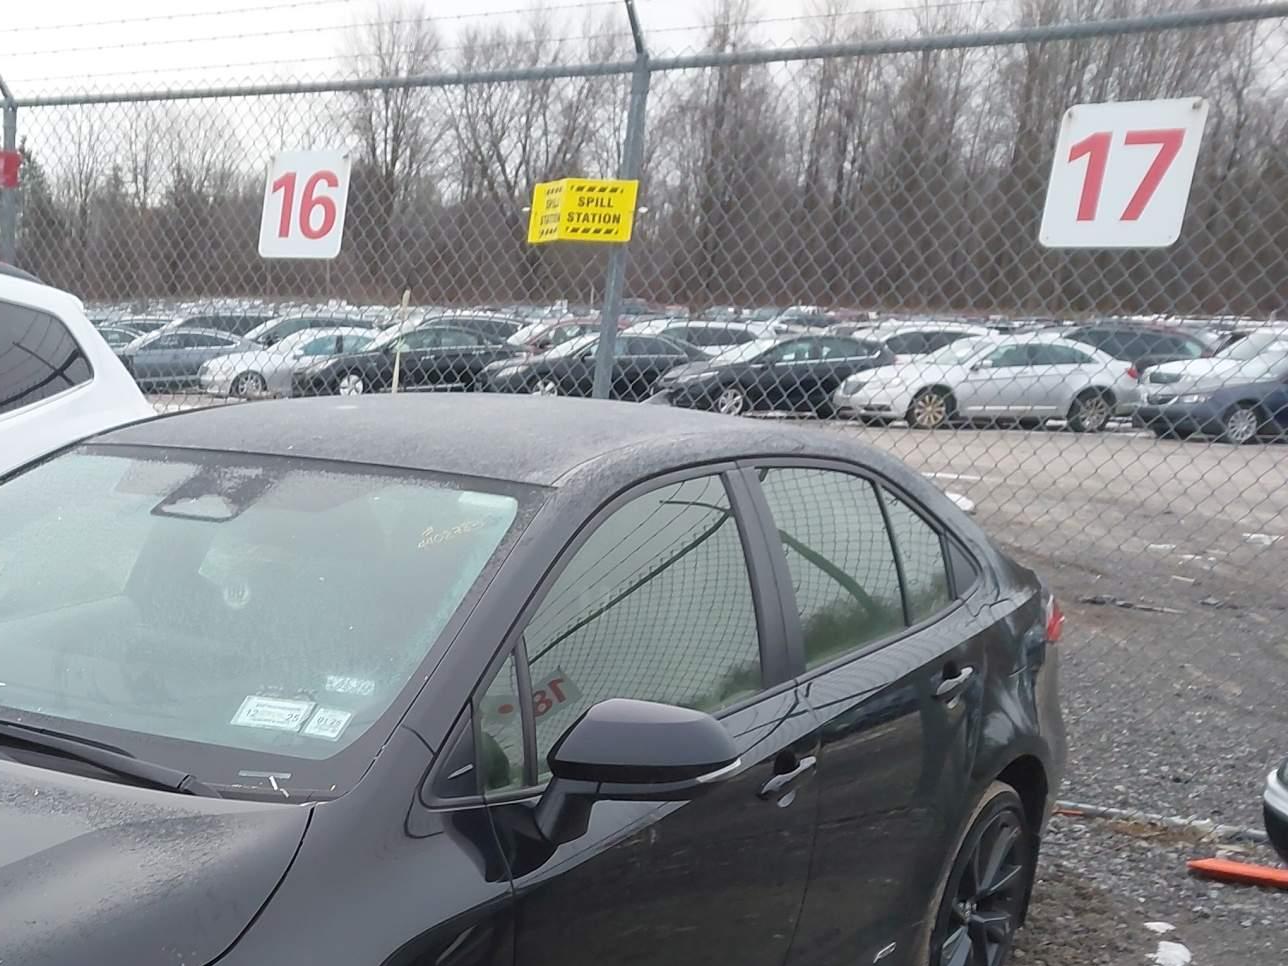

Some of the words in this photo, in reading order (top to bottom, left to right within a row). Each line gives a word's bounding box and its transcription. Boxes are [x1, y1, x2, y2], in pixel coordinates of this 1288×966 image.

[1068, 128, 1185, 222] 17
[272, 170, 339, 240] 16
[567, 212, 621, 224] STATION
[577, 196, 614, 208] SPILL
